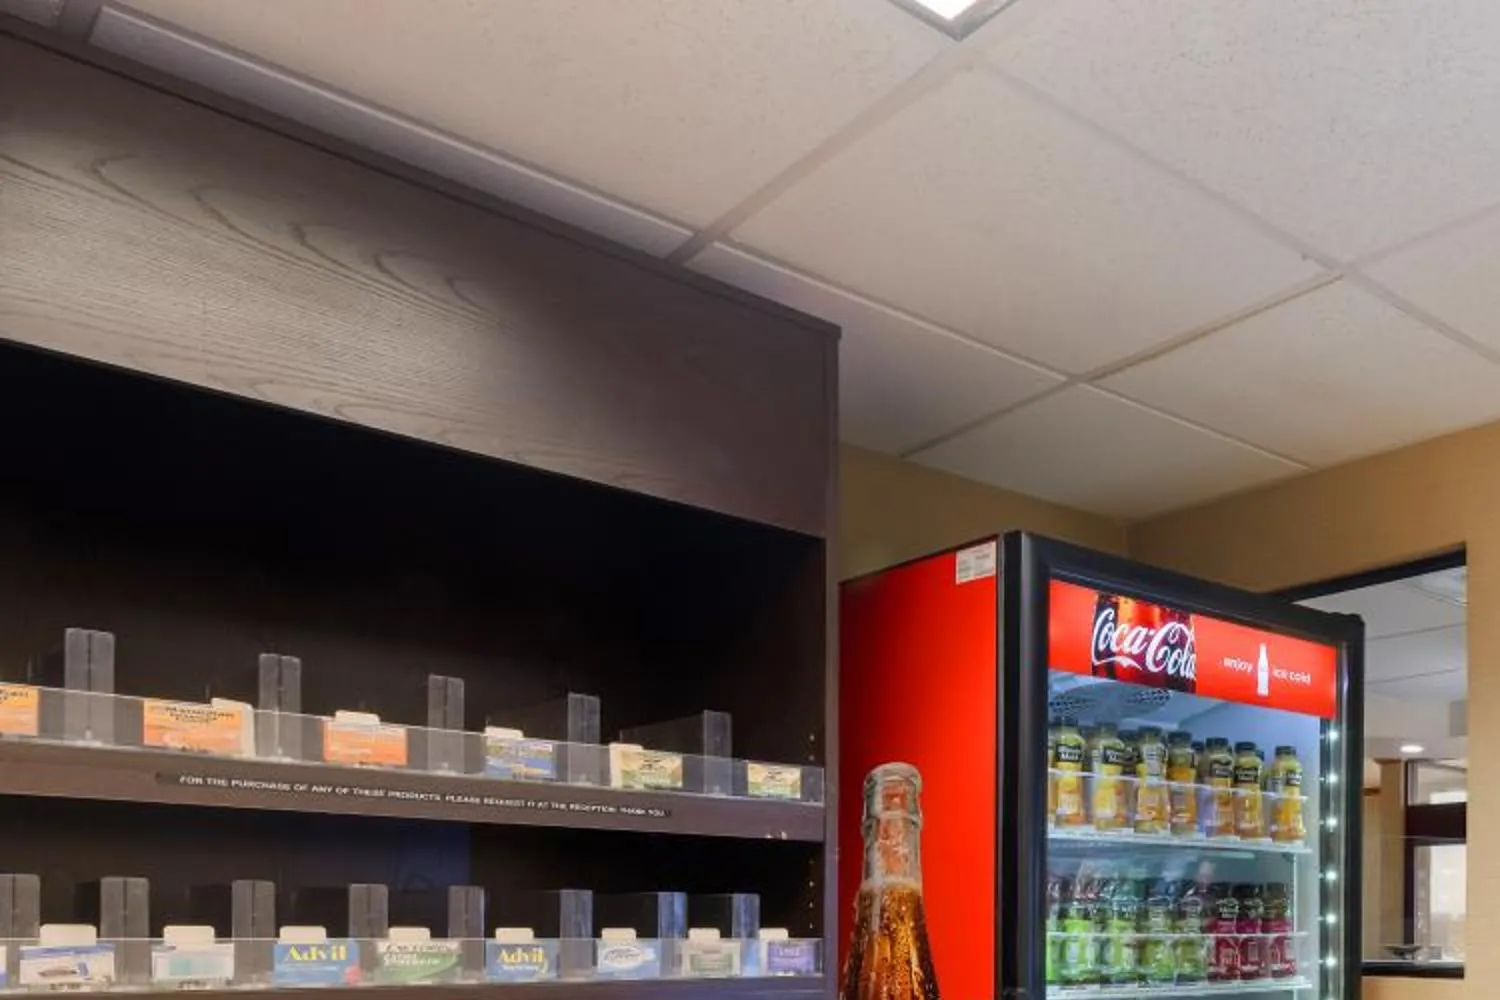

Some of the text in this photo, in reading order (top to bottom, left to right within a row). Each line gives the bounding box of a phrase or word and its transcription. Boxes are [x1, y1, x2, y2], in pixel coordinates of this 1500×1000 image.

[1091, 606, 1198, 682] Coca-Cola
[179, 775, 203, 785] FOR
[205, 777, 229, 788] THE
[231, 779, 291, 792] PURCHASE
[293, 783, 308, 792] OF
[311, 784, 333, 794] ANY
[335, 786, 350, 795] OF
[352, 787, 385, 798] THESE
[286, 945, 348, 962] Advil
[497, 948, 545, 965] Advil
